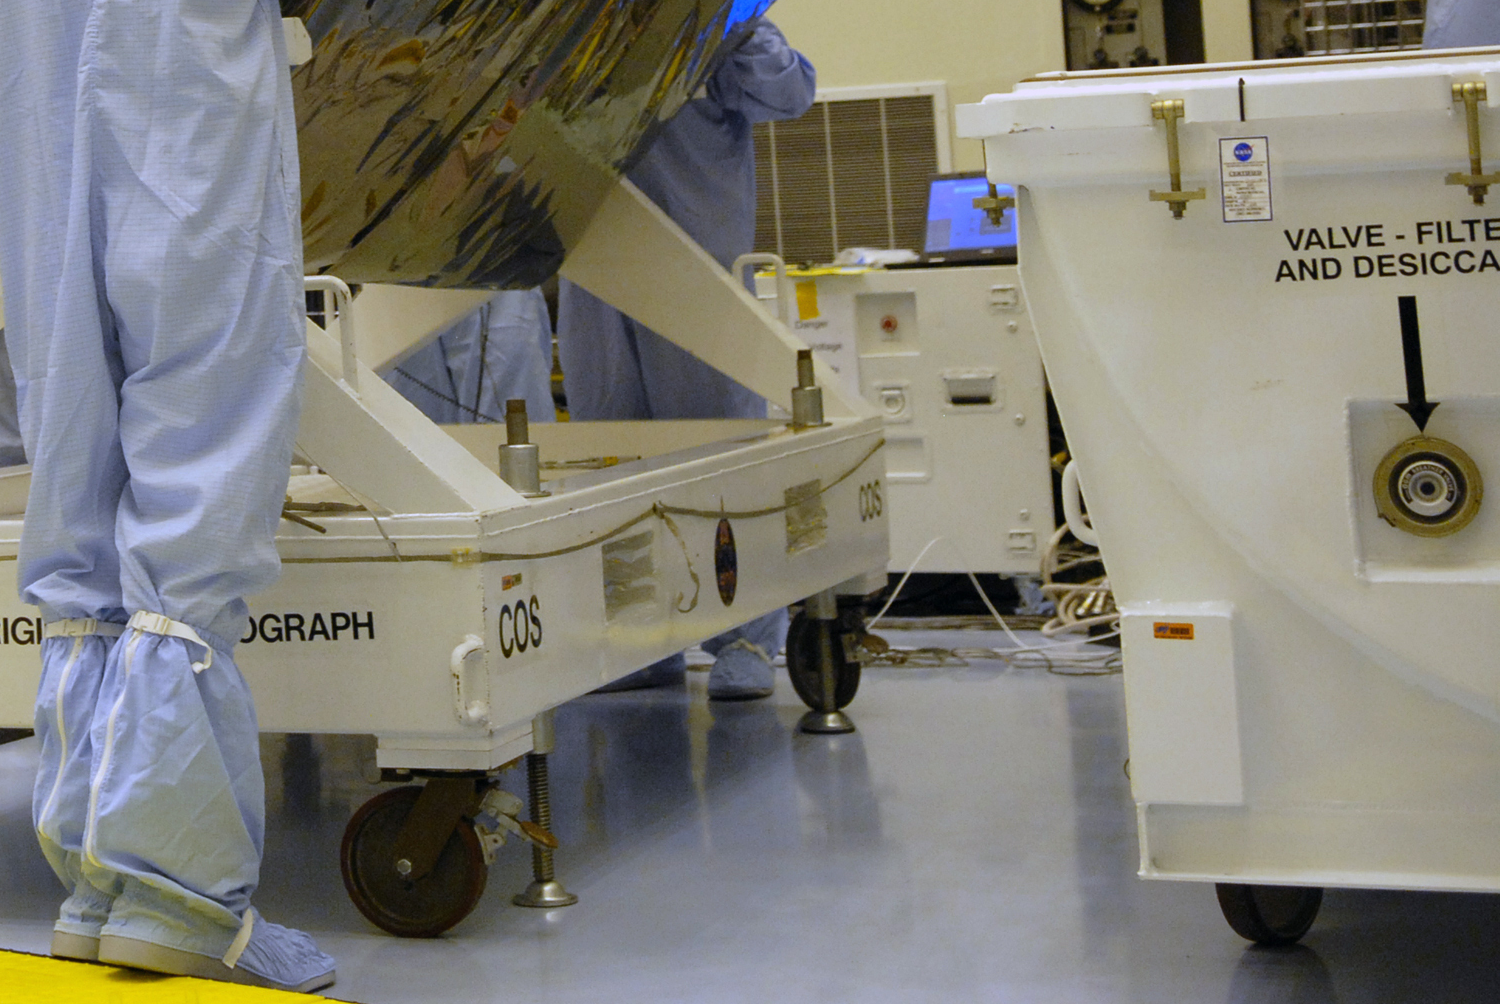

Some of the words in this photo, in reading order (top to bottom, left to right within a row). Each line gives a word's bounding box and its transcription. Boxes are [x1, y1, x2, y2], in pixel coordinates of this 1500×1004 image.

[1283, 224, 1385, 251] VALVE
[1416, 218, 1500, 244] FILTE
[1275, 257, 1342, 282] AND
[1353, 249, 1500, 279] DESICCA
[859, 479, 883, 522] COS
[240, 610, 375, 643] OGRAPH
[499, 594, 542, 659] COS
